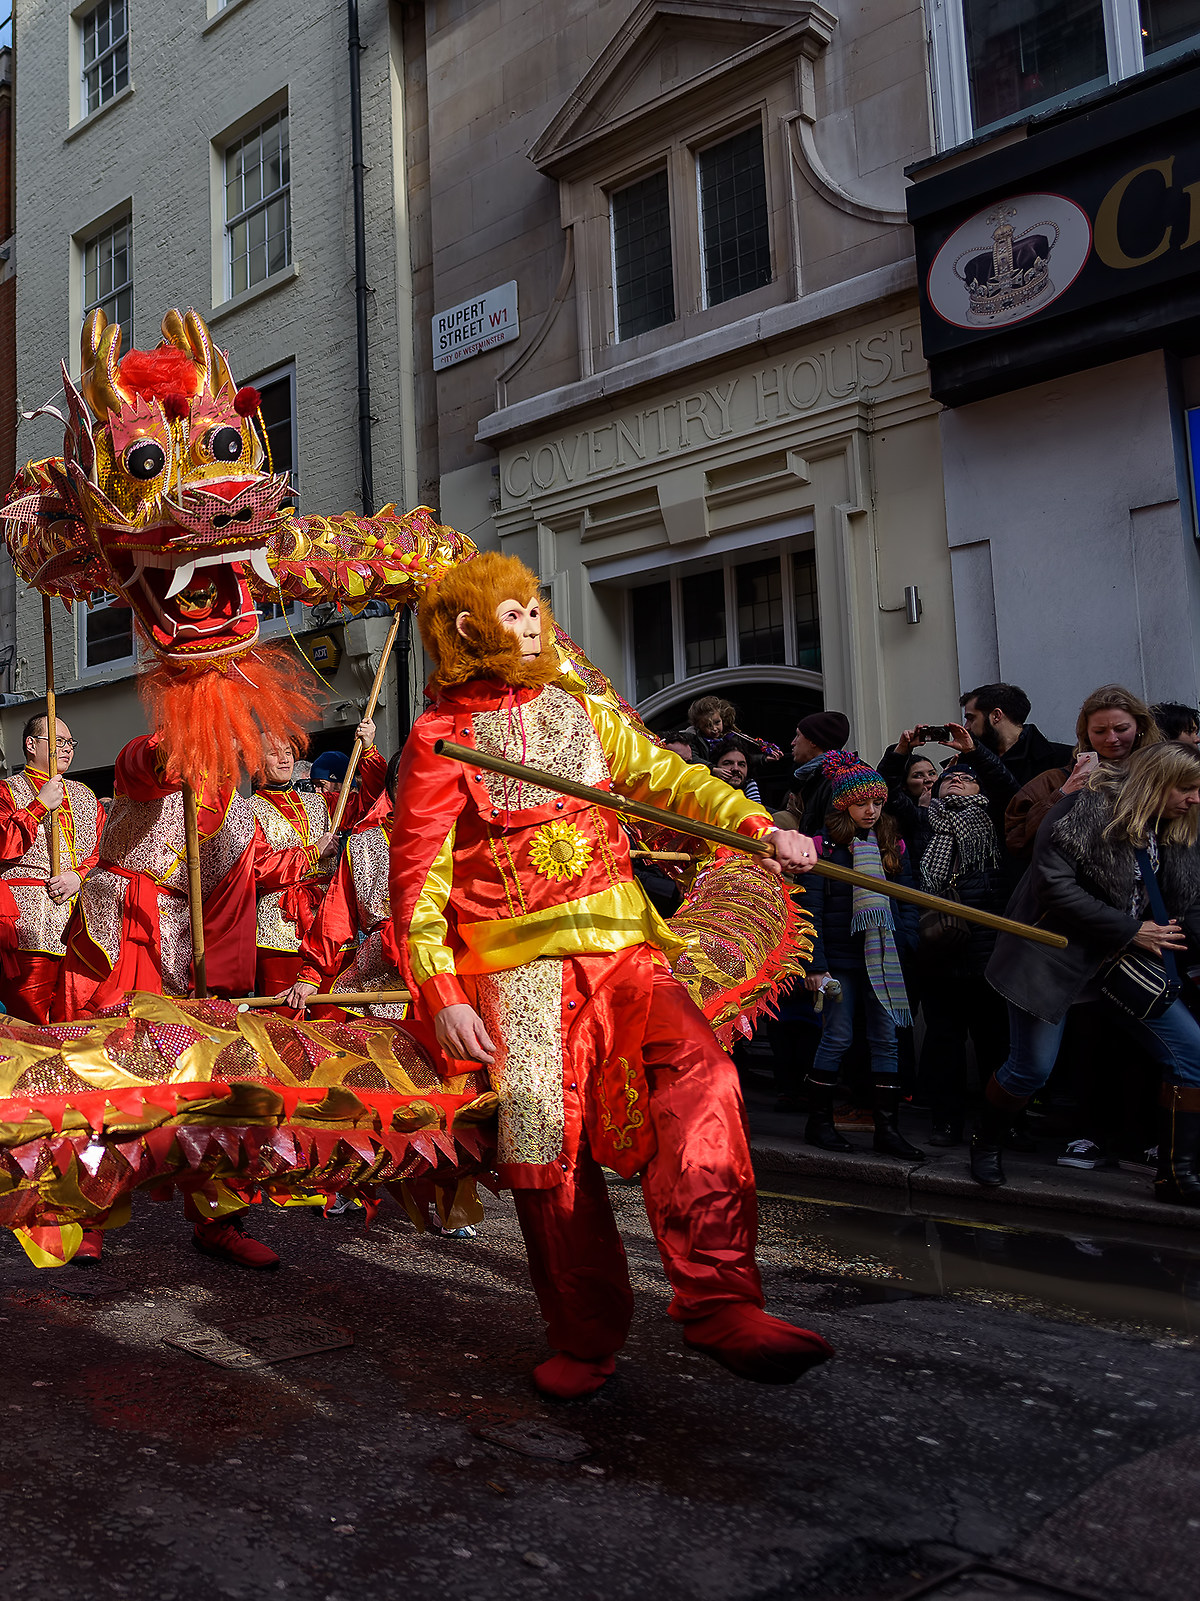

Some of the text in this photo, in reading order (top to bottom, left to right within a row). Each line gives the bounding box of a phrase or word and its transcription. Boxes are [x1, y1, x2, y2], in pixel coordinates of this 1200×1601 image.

[438, 299, 487, 334] RUPERT
[439, 307, 508, 350] STREET W1
[441, 332, 505, 363] CITY OF WESTMINSTER
[504, 324, 915, 498] COVENTRY HOUSE
[314, 647, 327, 659] ADT
